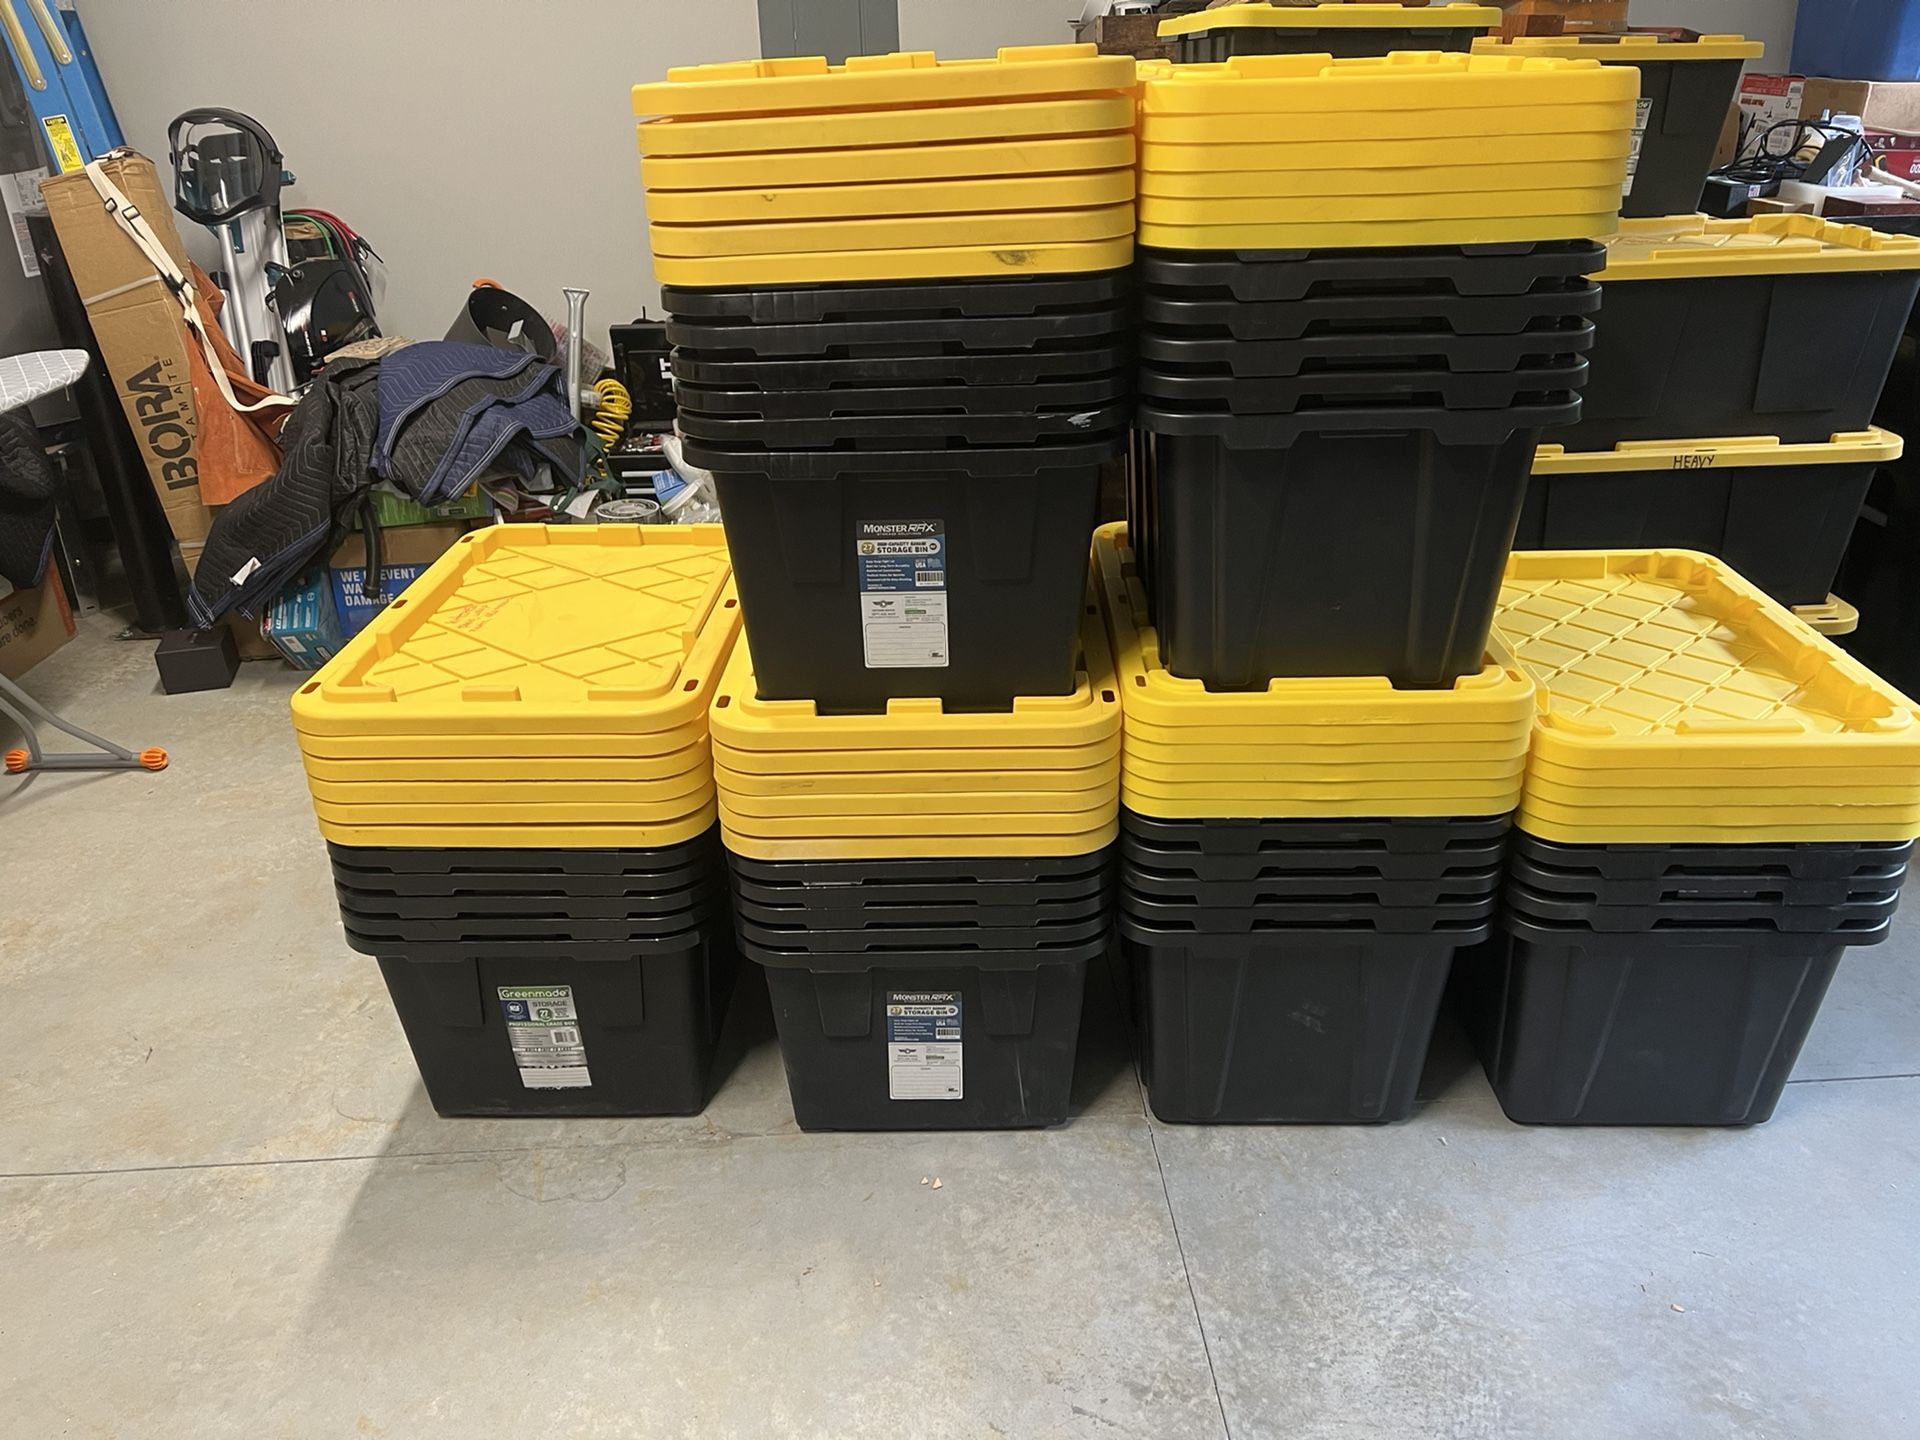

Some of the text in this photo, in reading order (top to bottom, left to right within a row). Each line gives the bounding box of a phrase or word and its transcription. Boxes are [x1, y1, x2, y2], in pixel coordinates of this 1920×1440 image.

[126, 361, 199, 490] BORA
[1673, 455, 1715, 469] HEAVY
[863, 543, 873, 551] 27
[340, 568, 415, 582] WE EVENT
[502, 989, 566, 998] Greenmade
